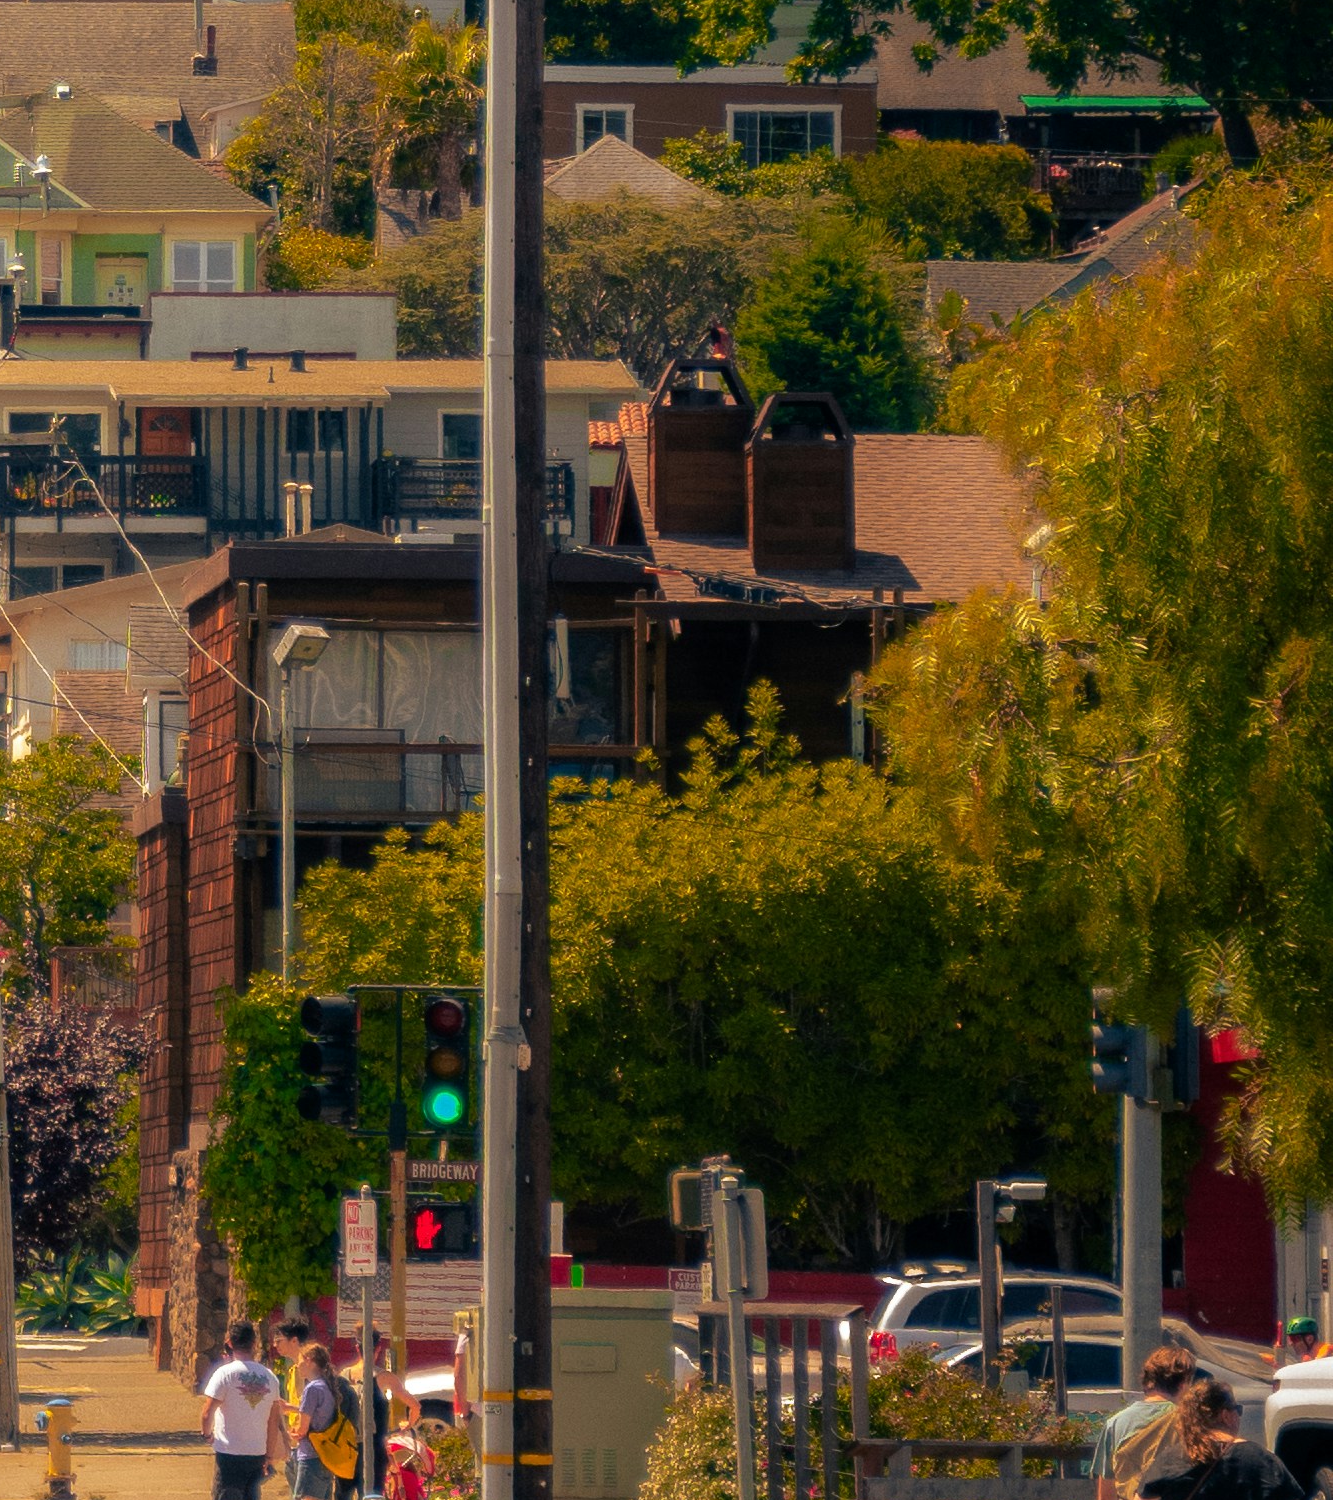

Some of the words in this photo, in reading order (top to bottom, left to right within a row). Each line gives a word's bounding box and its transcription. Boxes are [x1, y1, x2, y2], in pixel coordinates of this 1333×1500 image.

[412, 1162, 479, 1180] BRIDGEWAY
[347, 1204, 358, 1221] NO
[348, 1226, 374, 1242] PARKING
[677, 1272, 700, 1283] CUST
